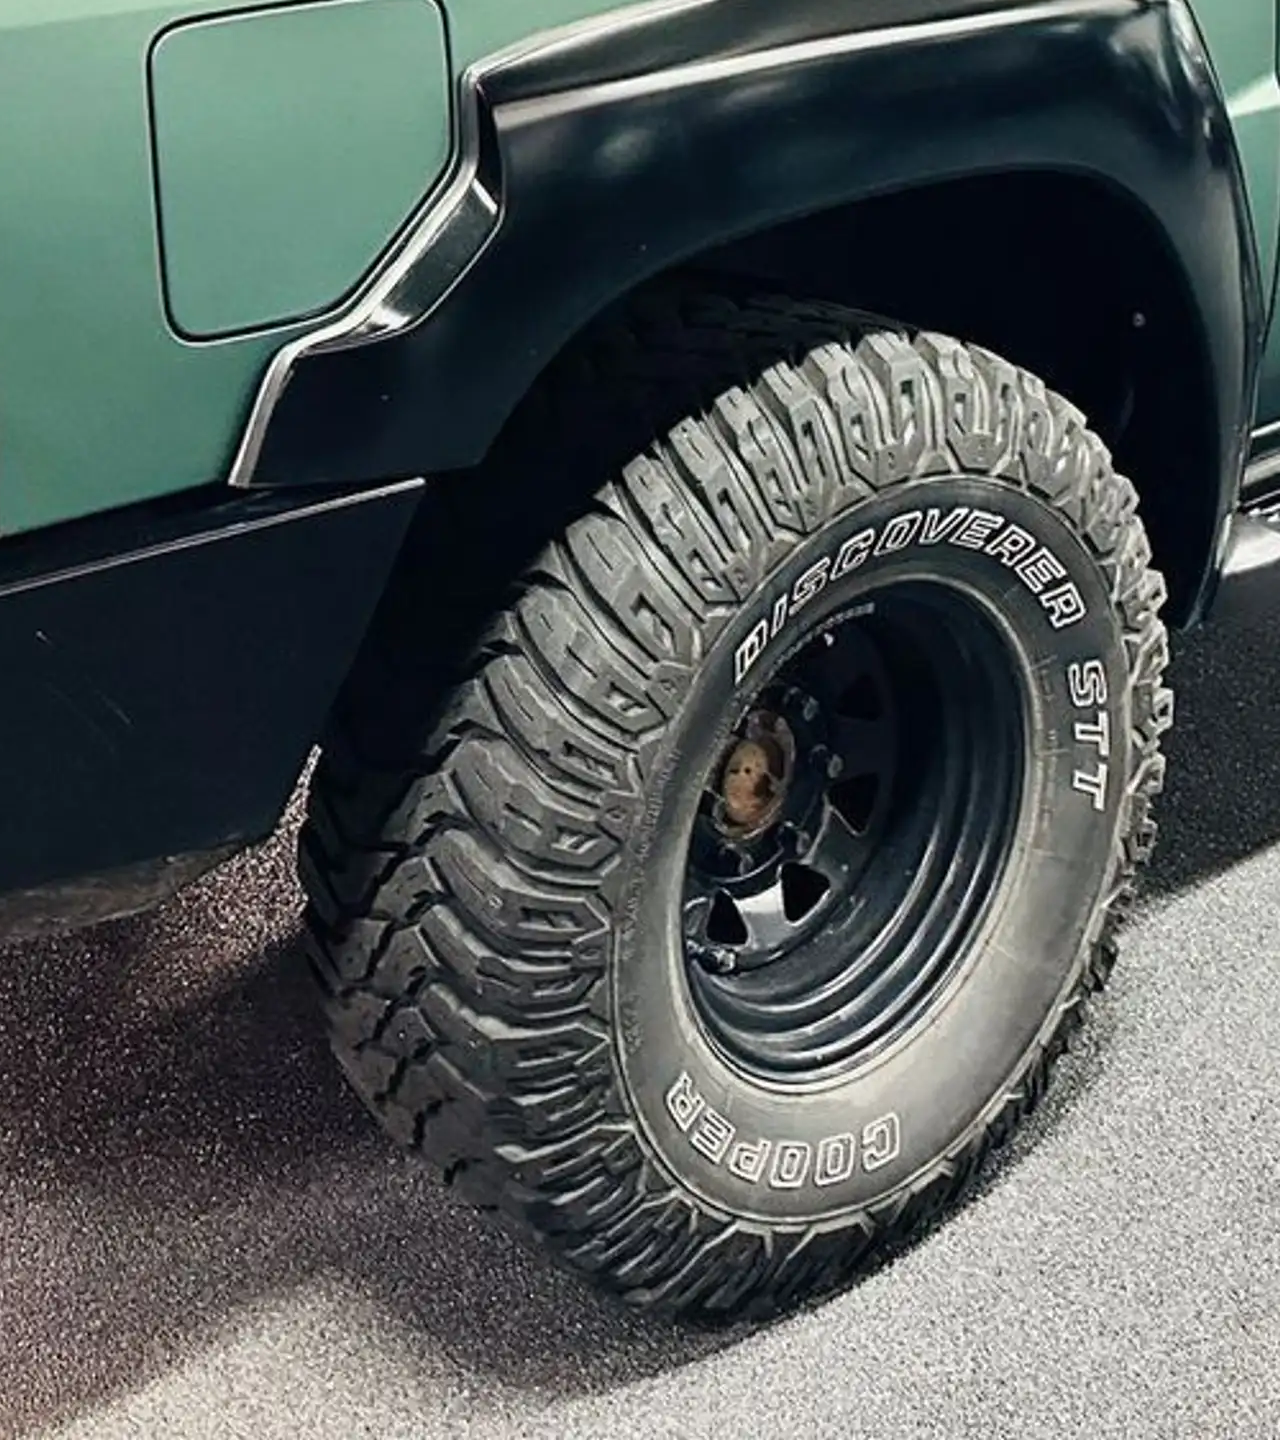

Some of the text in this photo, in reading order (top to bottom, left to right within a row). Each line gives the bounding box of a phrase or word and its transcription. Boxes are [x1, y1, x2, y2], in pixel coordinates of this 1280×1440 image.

[734, 507, 1109, 810] DISCOVERER STT
[666, 1071, 900, 1188] COOPER
